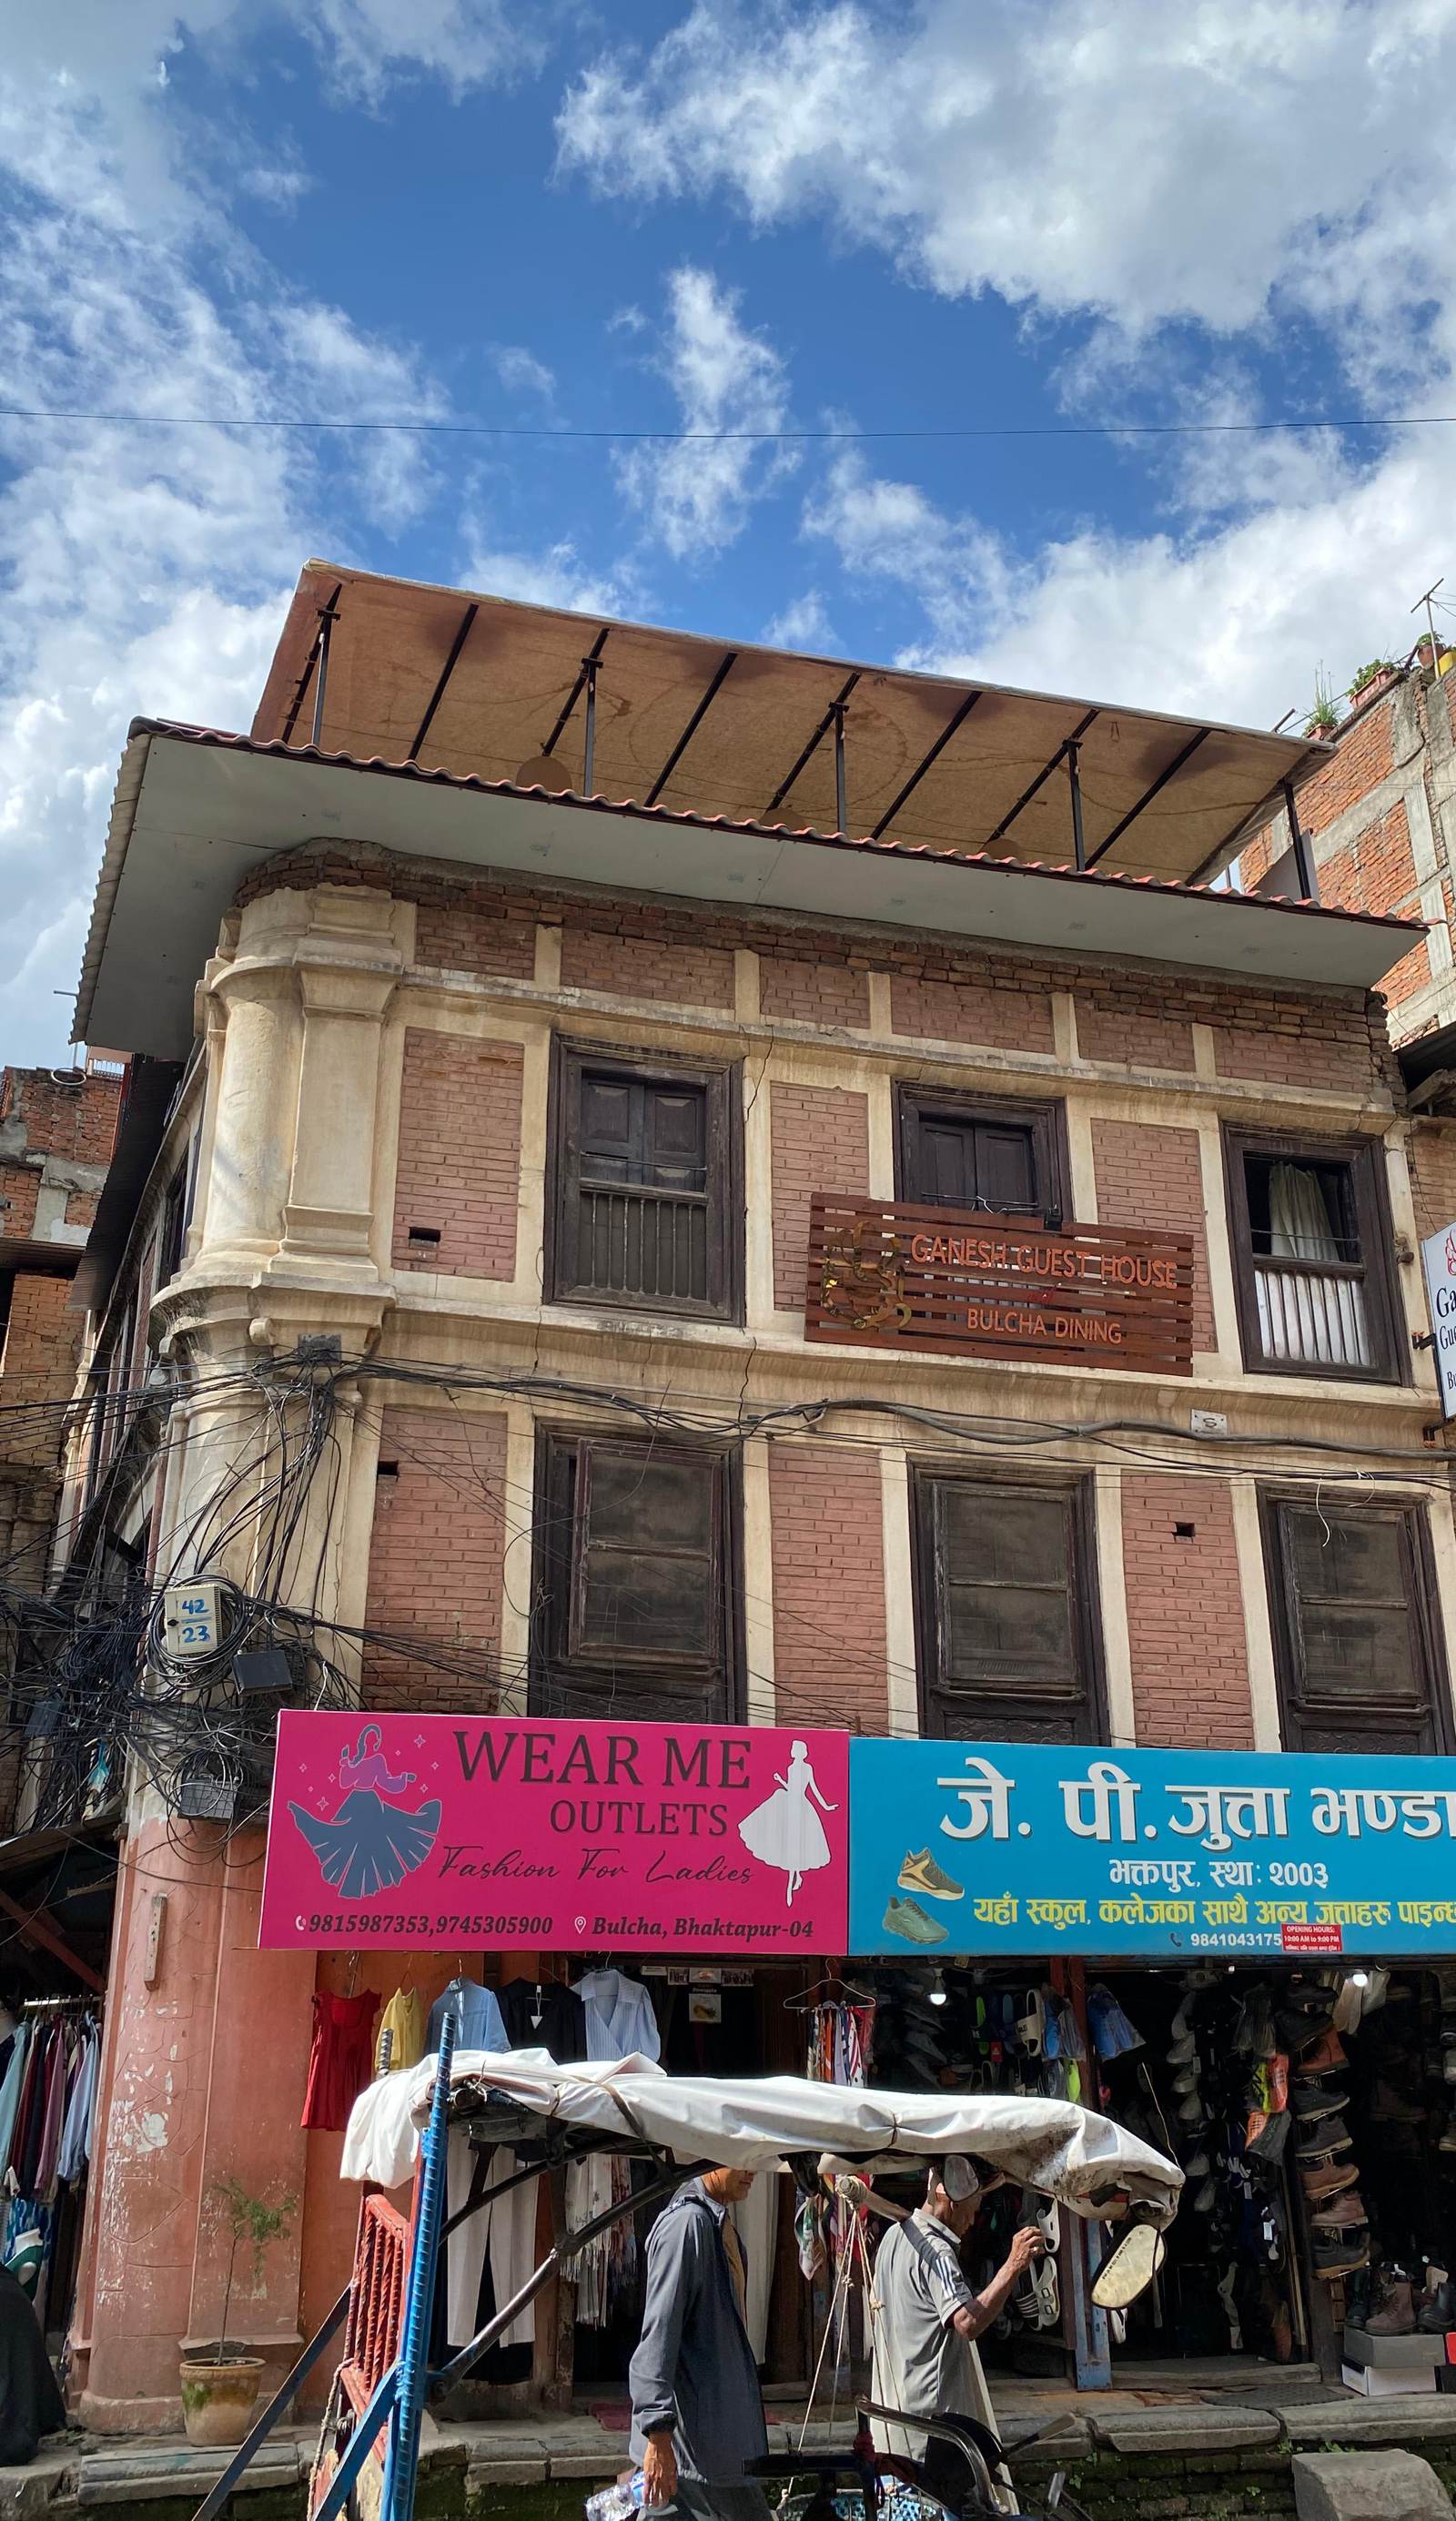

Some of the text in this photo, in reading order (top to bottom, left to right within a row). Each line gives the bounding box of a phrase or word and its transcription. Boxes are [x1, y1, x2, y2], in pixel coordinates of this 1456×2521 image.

[911, 1233, 1178, 1290] GANESH GUEST HOUSE
[967, 1308, 1122, 1344] BULCHA DINING
[181, 1598, 209, 1615] 42
[182, 1625, 210, 1644] 23
[452, 1731, 751, 1788] WEAR ME
[550, 1800, 728, 1836] OUTLETS
[438, 1845, 754, 1885] Fashion For Ladies
[1269, 1862, 1330, 1889] २००३
[974, 1891, 1019, 1925] यहाँ
[1098, 1892, 1196, 1924] कलेजका
[309, 1914, 553, 1936] 9815987353,9745305900
[592, 1916, 814, 1941] Bulcha, Bhaktapur-04
[1190, 1930, 1282, 1946] 9841043175
